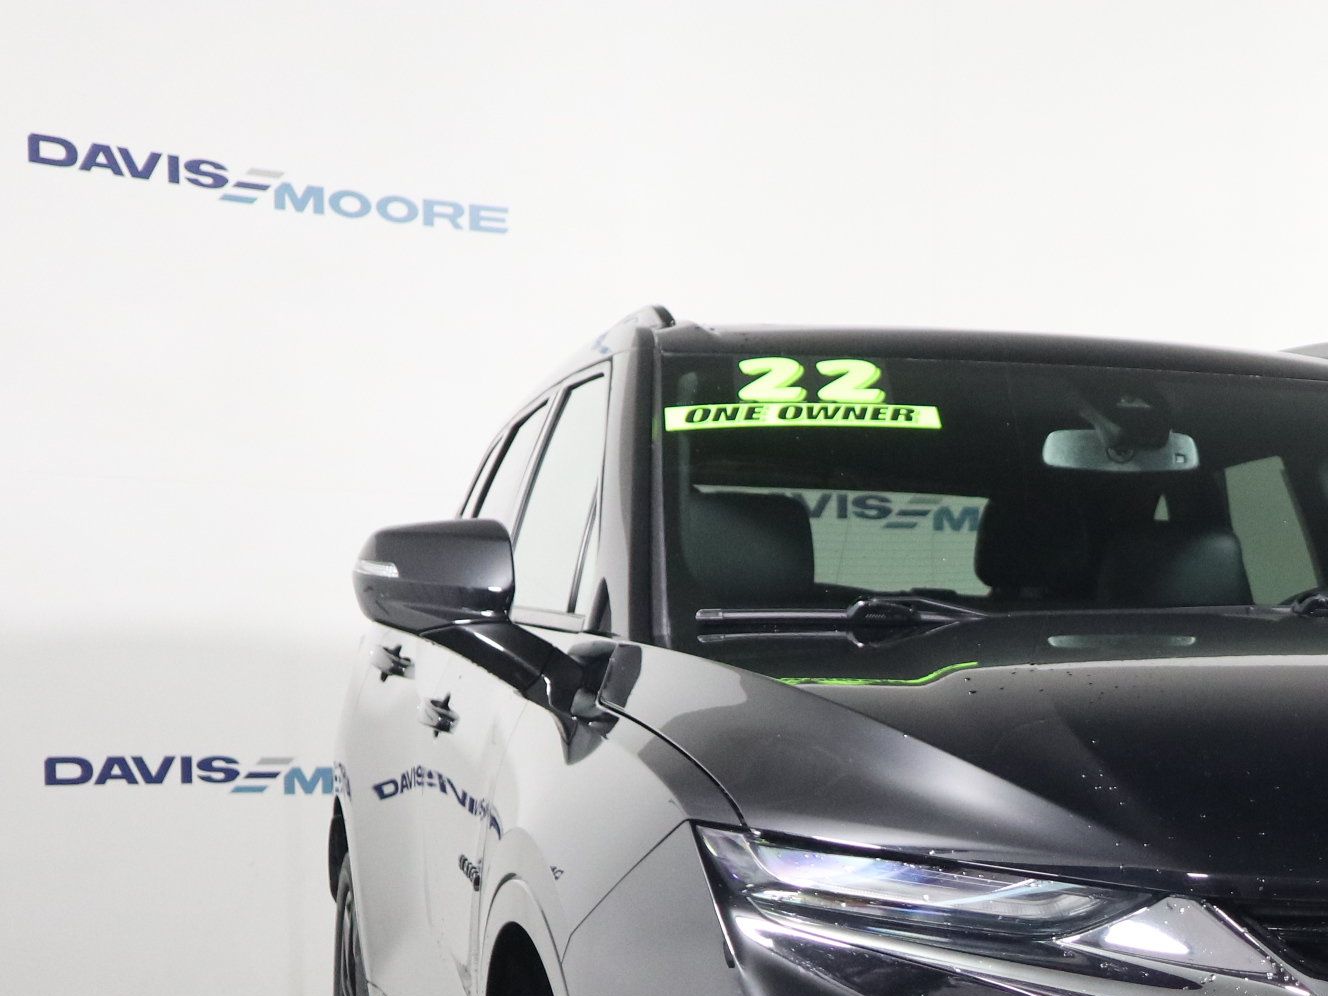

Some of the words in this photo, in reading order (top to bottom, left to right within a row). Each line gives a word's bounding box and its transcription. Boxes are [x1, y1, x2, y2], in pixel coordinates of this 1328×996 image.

[27, 132, 229, 189] DAVIS
[273, 182, 509, 234] MOORE
[738, 357, 886, 403] 22
[685, 405, 765, 424] ONE
[778, 404, 915, 422] OWNER
[784, 492, 893, 520] VIS
[44, 755, 240, 786] DAVIS
